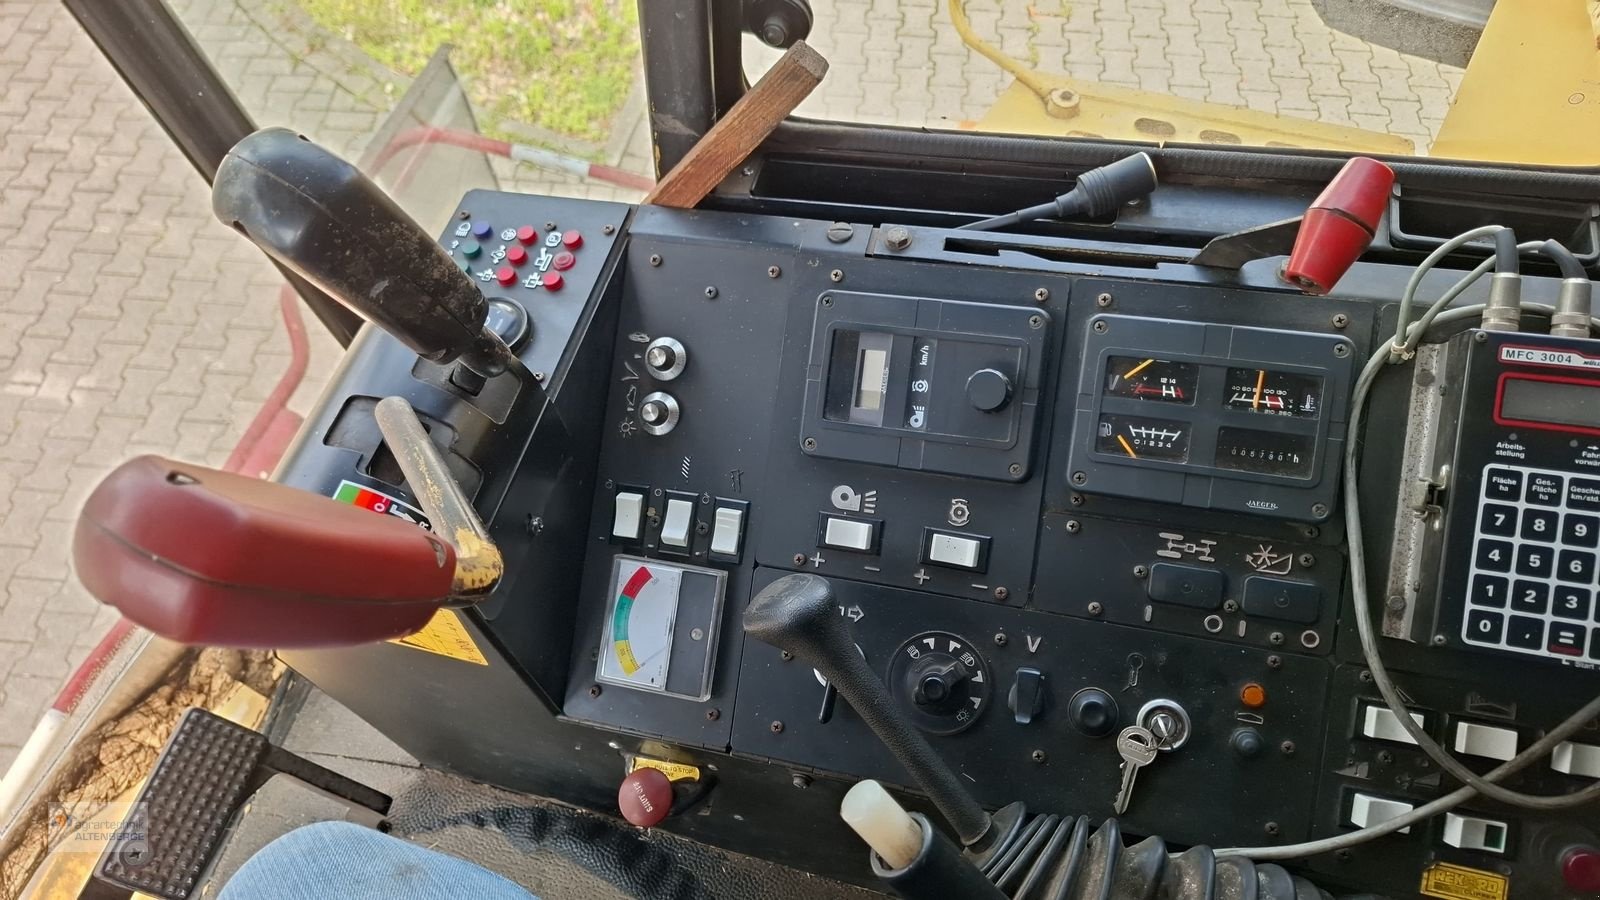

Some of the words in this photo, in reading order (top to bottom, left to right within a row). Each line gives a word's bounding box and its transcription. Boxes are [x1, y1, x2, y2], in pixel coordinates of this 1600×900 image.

[919, 345, 929, 366] km/h
[1505, 349, 1534, 360] MFC
[1540, 352, 1572, 363] 3004
[1496, 441, 1526, 451] Arbeits-
[1495, 449, 1525, 459] stellung
[1492, 476, 1517, 485] Fläche
[1531, 485, 1557, 494] Fläche
[1246, 500, 1279, 510] JAEGER
[1494, 514, 1505, 526] 7
[1533, 519, 1545, 532] 8
[1574, 524, 1587, 537] 9
[1488, 549, 1500, 562] 4
[1529, 554, 1541, 567] 5
[1569, 560, 1582, 573] 6
[1485, 585, 1494, 597] 1
[1524, 590, 1536, 603] 2
[1565, 595, 1578, 609] 3
[1479, 619, 1491, 632] 0
